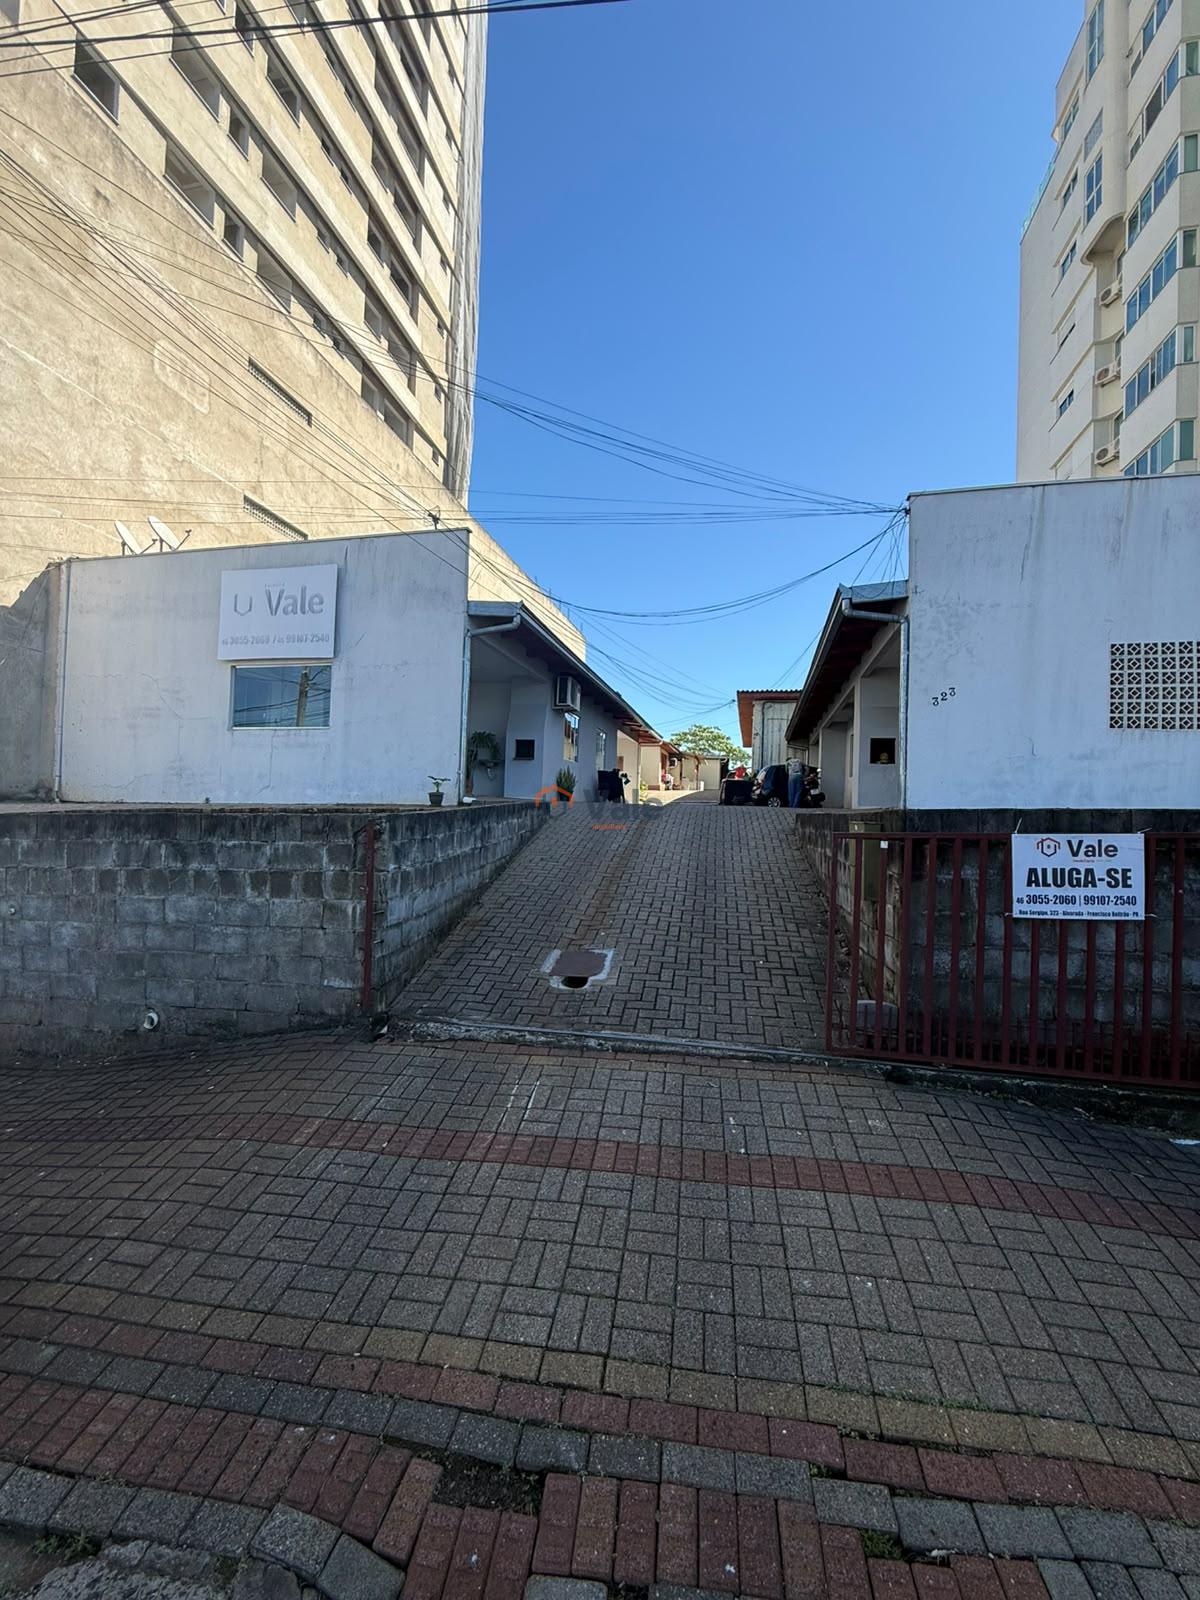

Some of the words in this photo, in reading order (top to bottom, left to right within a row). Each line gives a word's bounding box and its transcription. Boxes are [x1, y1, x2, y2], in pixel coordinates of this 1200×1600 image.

[264, 585, 325, 616] Vale
[931, 687, 956, 707] 323
[1066, 839, 1119, 858] Vale
[1026, 867, 1133, 888] ALUGA-SE
[1025, 894, 1077, 905] 3055-2060
[1083, 894, 1137, 906] 99107-2540
